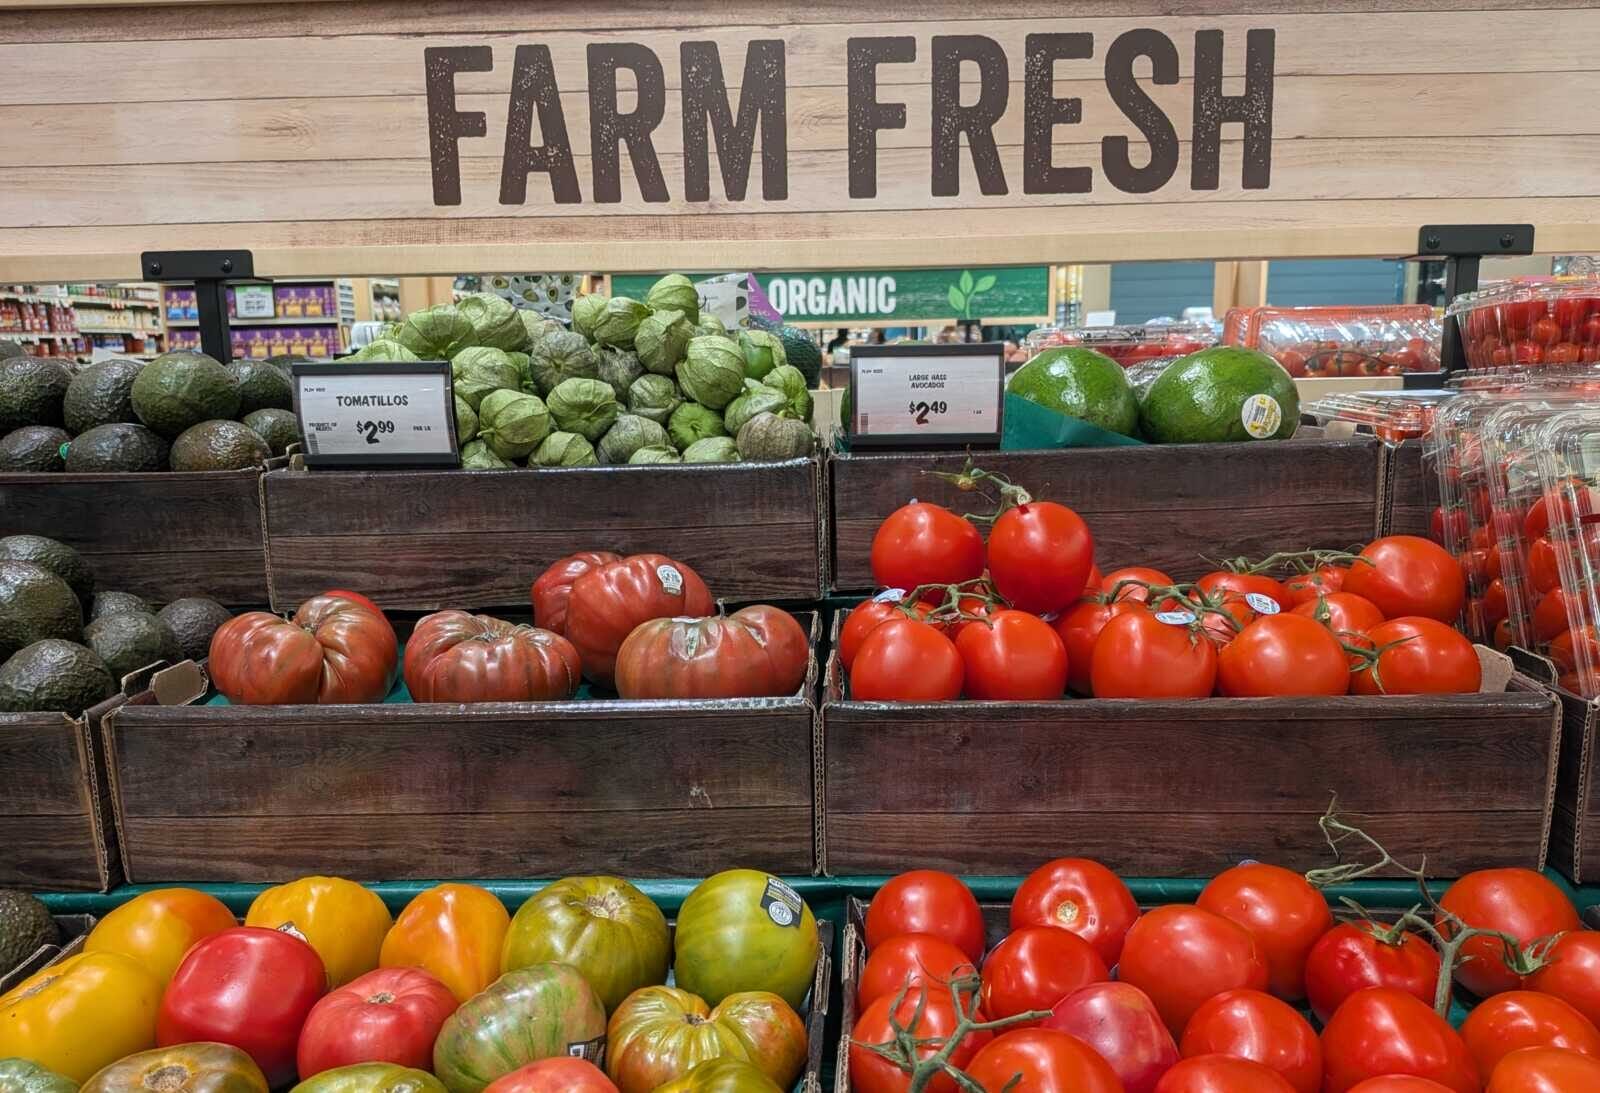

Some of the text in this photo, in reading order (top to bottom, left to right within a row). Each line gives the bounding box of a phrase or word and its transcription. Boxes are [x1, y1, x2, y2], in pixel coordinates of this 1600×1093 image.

[424, 28, 1276, 206] FARM FRESH
[768, 276, 897, 316] ORGANIC
[931, 373, 948, 381] HASS
[910, 381, 945, 389] AVOCADOS
[336, 395, 409, 407] TOMATILLOS
